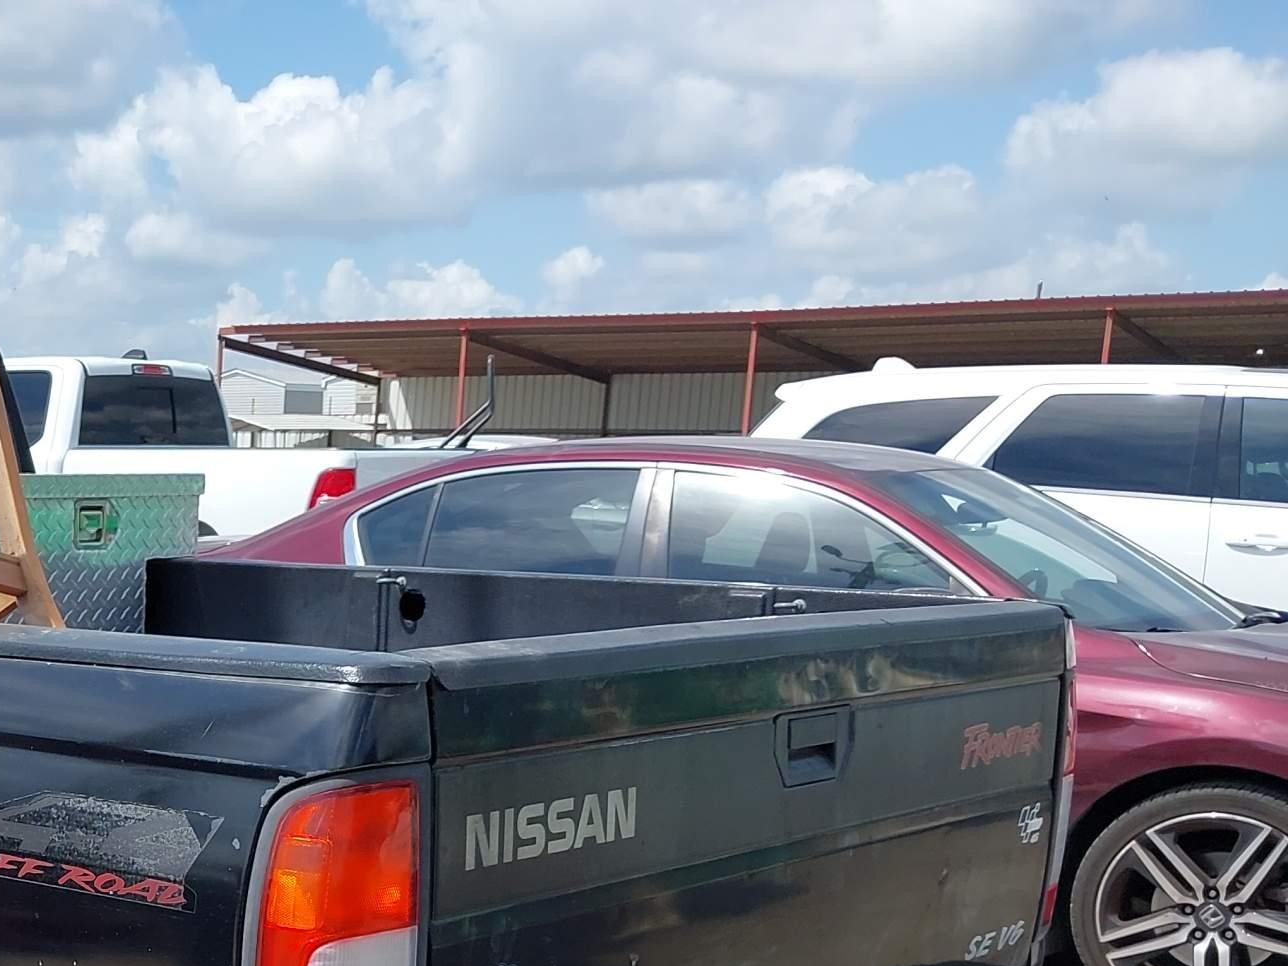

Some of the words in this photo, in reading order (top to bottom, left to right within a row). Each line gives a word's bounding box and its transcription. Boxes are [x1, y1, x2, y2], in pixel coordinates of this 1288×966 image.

[465, 786, 638, 871] NISSAN
[57, 864, 187, 906] ROAD
[964, 931, 997, 961] SE
[997, 920, 1025, 951] V6
